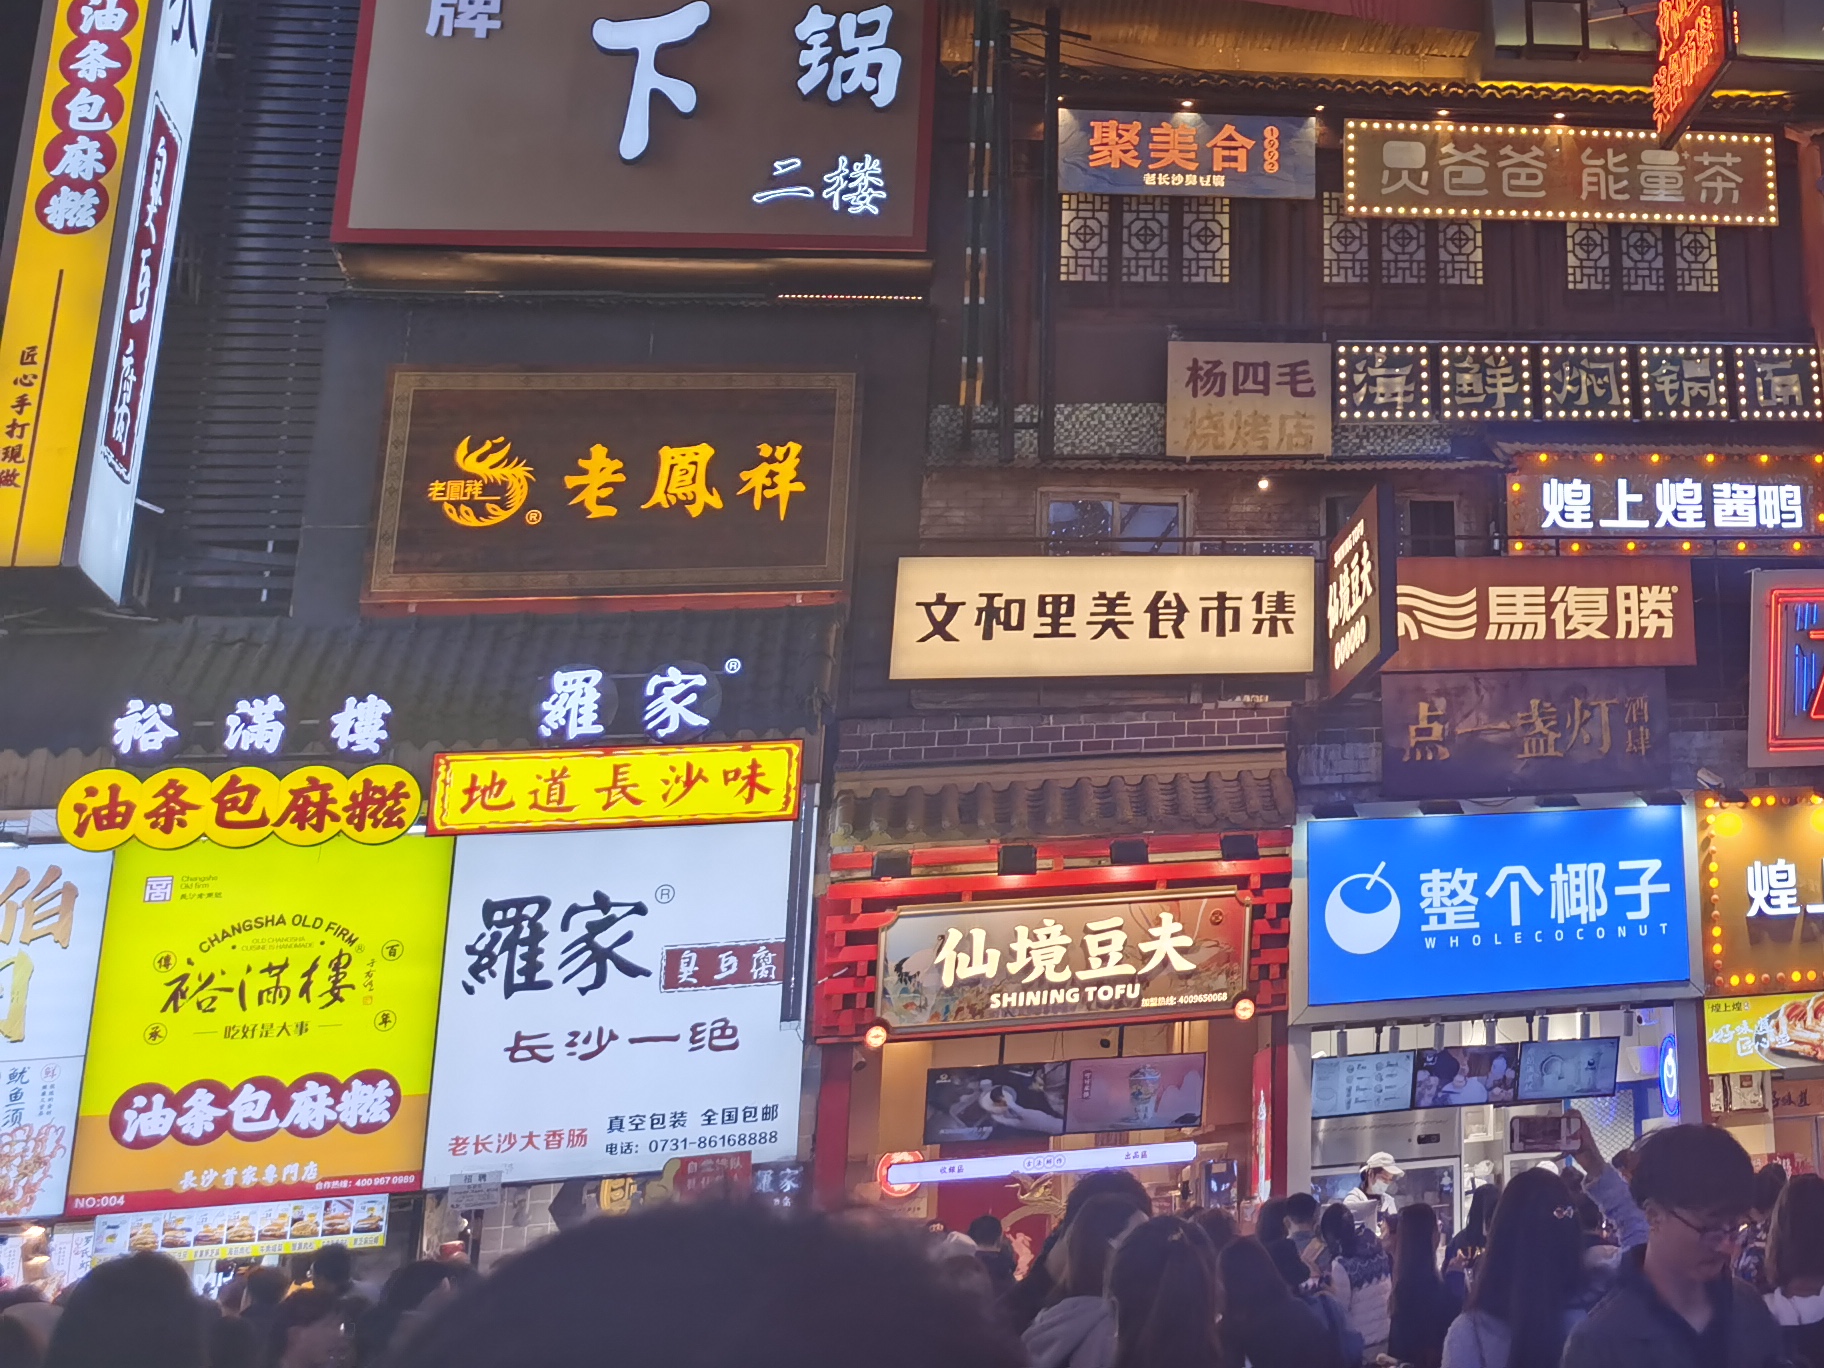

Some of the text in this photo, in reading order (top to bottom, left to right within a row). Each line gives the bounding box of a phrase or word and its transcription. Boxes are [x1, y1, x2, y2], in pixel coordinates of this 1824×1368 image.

[1088, 118, 1256, 173] 聚美合
[752, 153, 889, 216] 二楼
[1143, 172, 1226, 189] 老长沙臭豆腐
[1580, 146, 1745, 206] 能量茶
[1185, 357, 1318, 399] 杨四毛
[564, 440, 807, 521] 老鳳祥
[1541, 477, 1804, 530] 煌上煌酱鸭
[915, 588, 1299, 644] 文和里美食市集
[1485, 584, 1676, 642] 馬復勝
[537, 665, 710, 740] 羅家
[1402, 693, 1620, 762] 点一盏灯
[459, 758, 776, 815] 地道長沙味
[1418, 858, 1672, 932] 整个椰子
[199, 913, 360, 954] CHANGSHA OLD FIRM
[461, 889, 653, 1000] 羅家
[933, 911, 1197, 988] 仙境豆夫
[677, 945, 780, 985] 臭豆腐
[989, 982, 1141, 1010] SHINING TOFU
[1710, 1000, 1743, 1013] 煌上煌
[223, 1019, 310, 1040] 吃好是大事
[503, 1017, 741, 1063] 长沙一绝
[448, 1126, 589, 1158] 老长沙大香肠
[607, 1103, 780, 1134] 真空包装 全国包邮
[648, 1129, 779, 1155] 0731-86168888
[74, 1194, 125, 1209] NO:004
